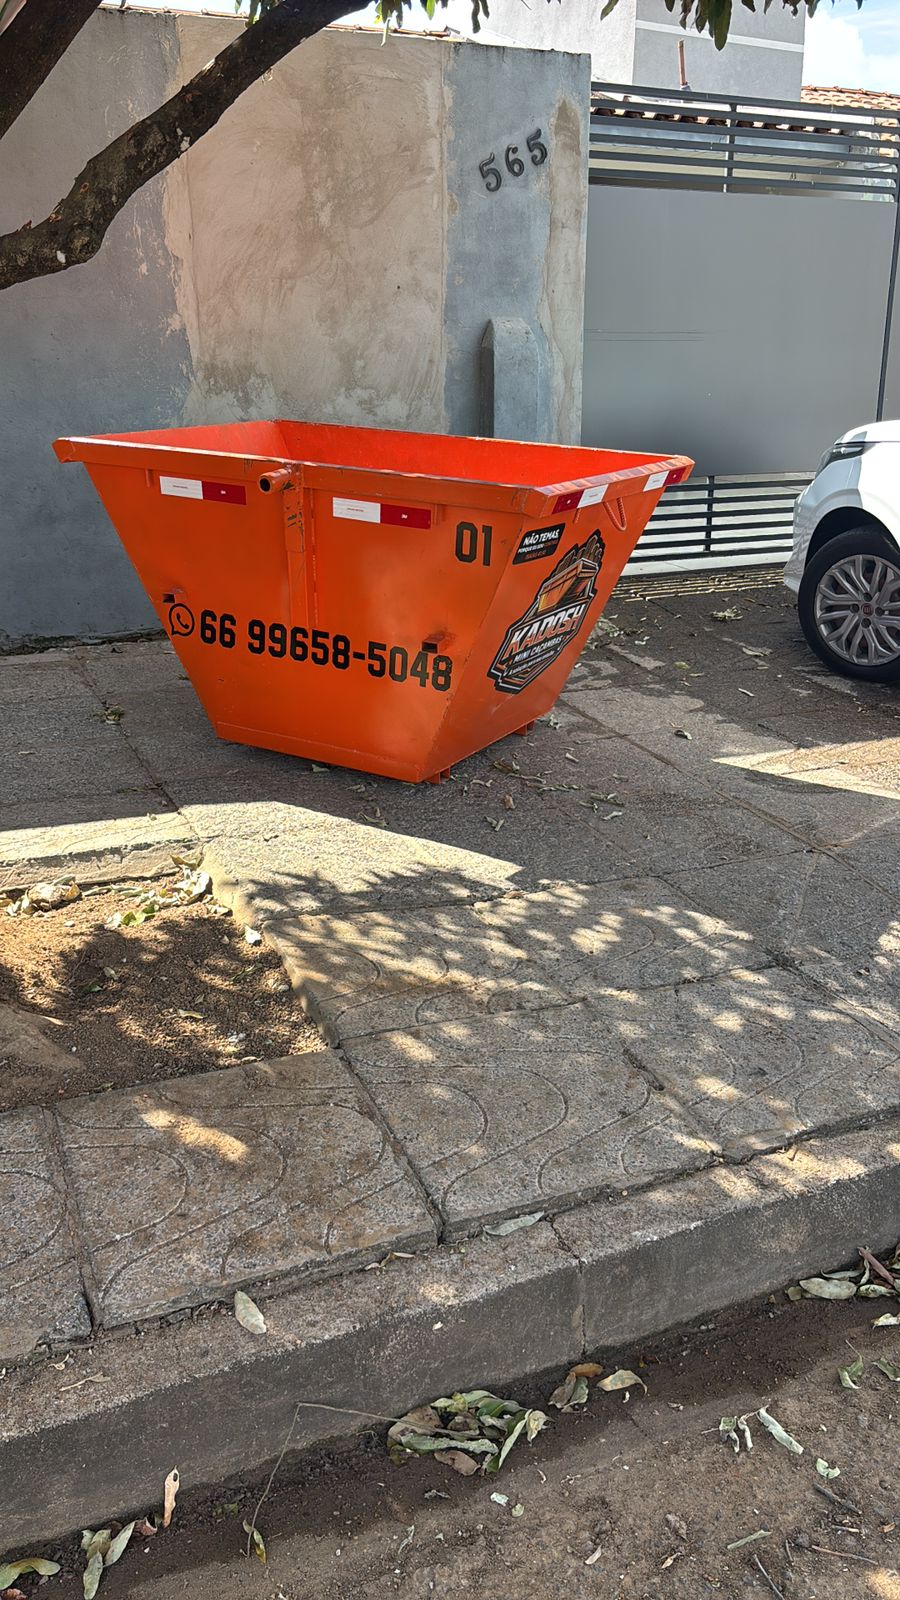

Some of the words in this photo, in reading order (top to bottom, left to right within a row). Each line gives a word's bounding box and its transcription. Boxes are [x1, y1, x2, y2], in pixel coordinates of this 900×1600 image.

[479, 128, 547, 192] 565
[455, 521, 492, 566] 01
[523, 532, 539, 545] NÃO
[201, 610, 236, 648] 66
[248, 619, 452, 691] 99658-5048
[502, 603, 586, 661] KADOSH
[514, 649, 531, 662] MINI
